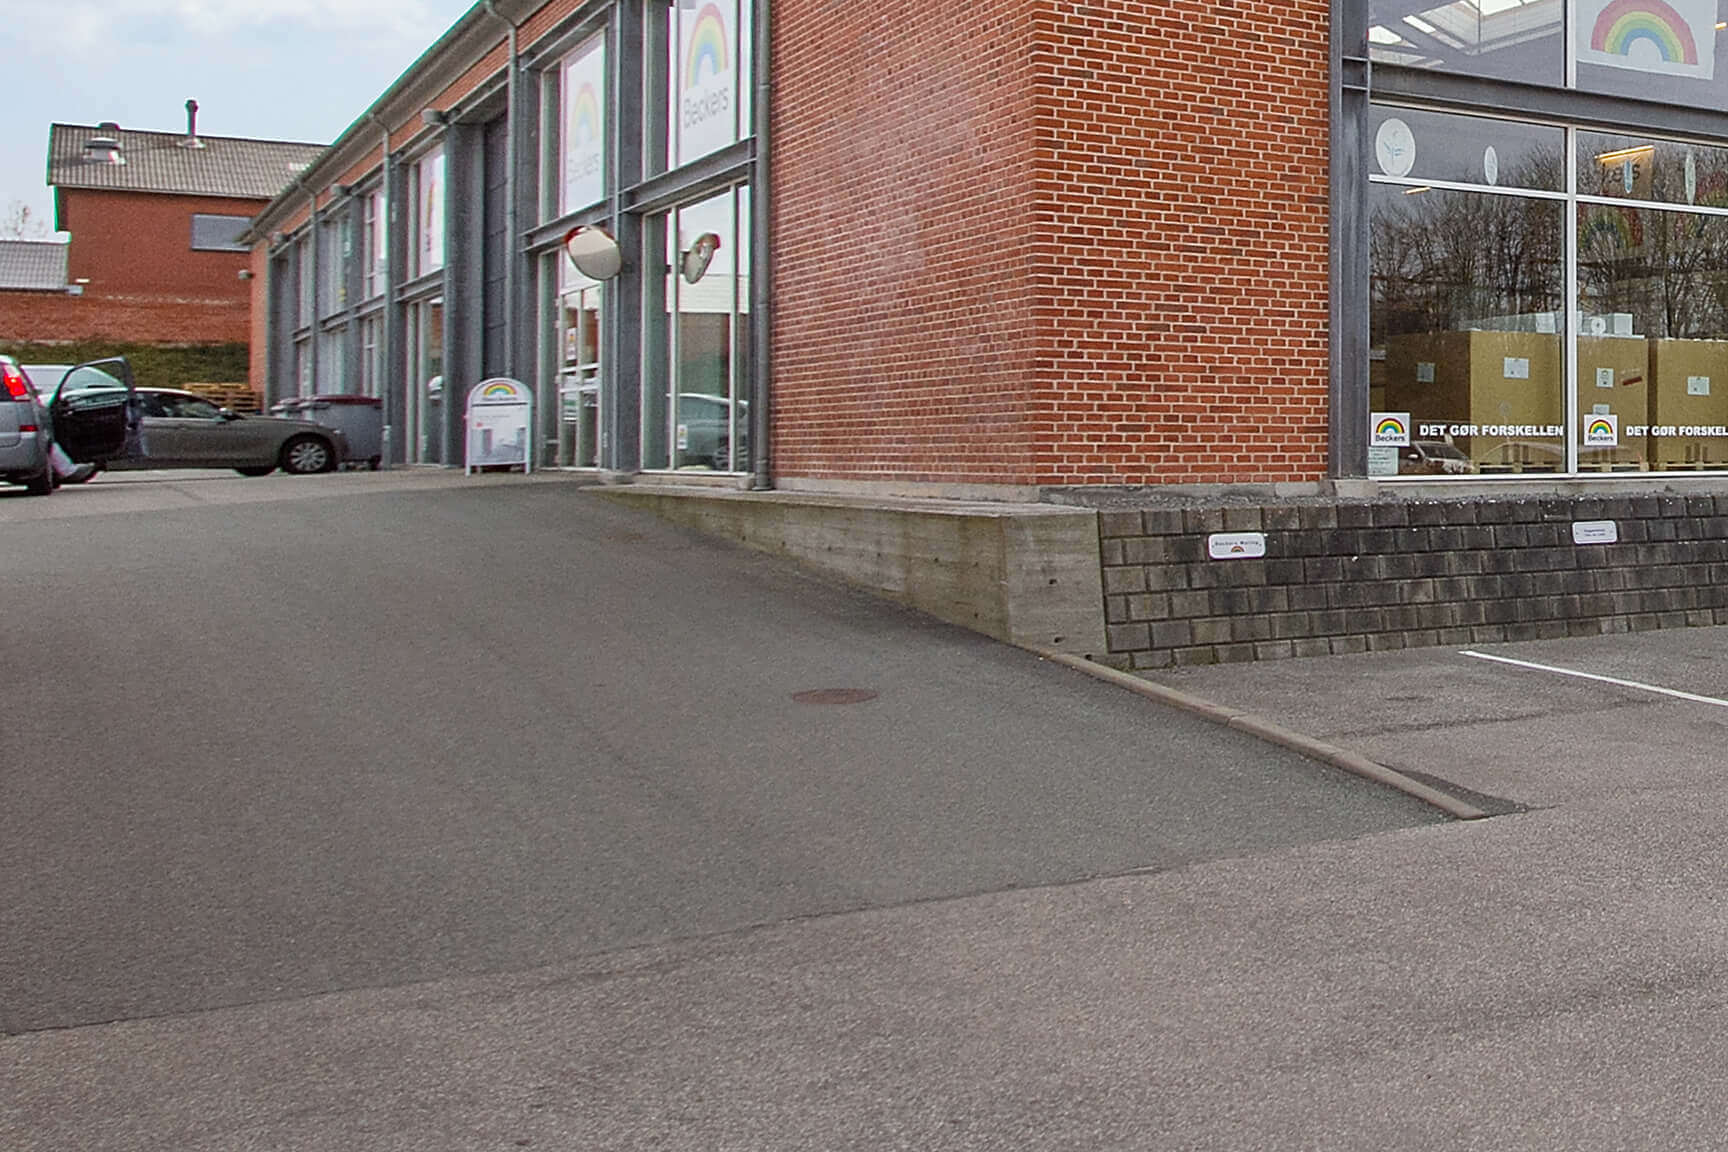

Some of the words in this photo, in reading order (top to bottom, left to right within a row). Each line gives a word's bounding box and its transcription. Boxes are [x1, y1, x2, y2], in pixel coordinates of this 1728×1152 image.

[683, 87, 729, 129] Beckers
[1419, 425, 1446, 436] DET
[1449, 425, 1478, 436] GØR
[1481, 425, 1564, 436] FORSKELLEN
[1625, 426, 1649, 436] DET
[1651, 426, 1676, 437] GØR
[1375, 434, 1405, 443] Beckers
